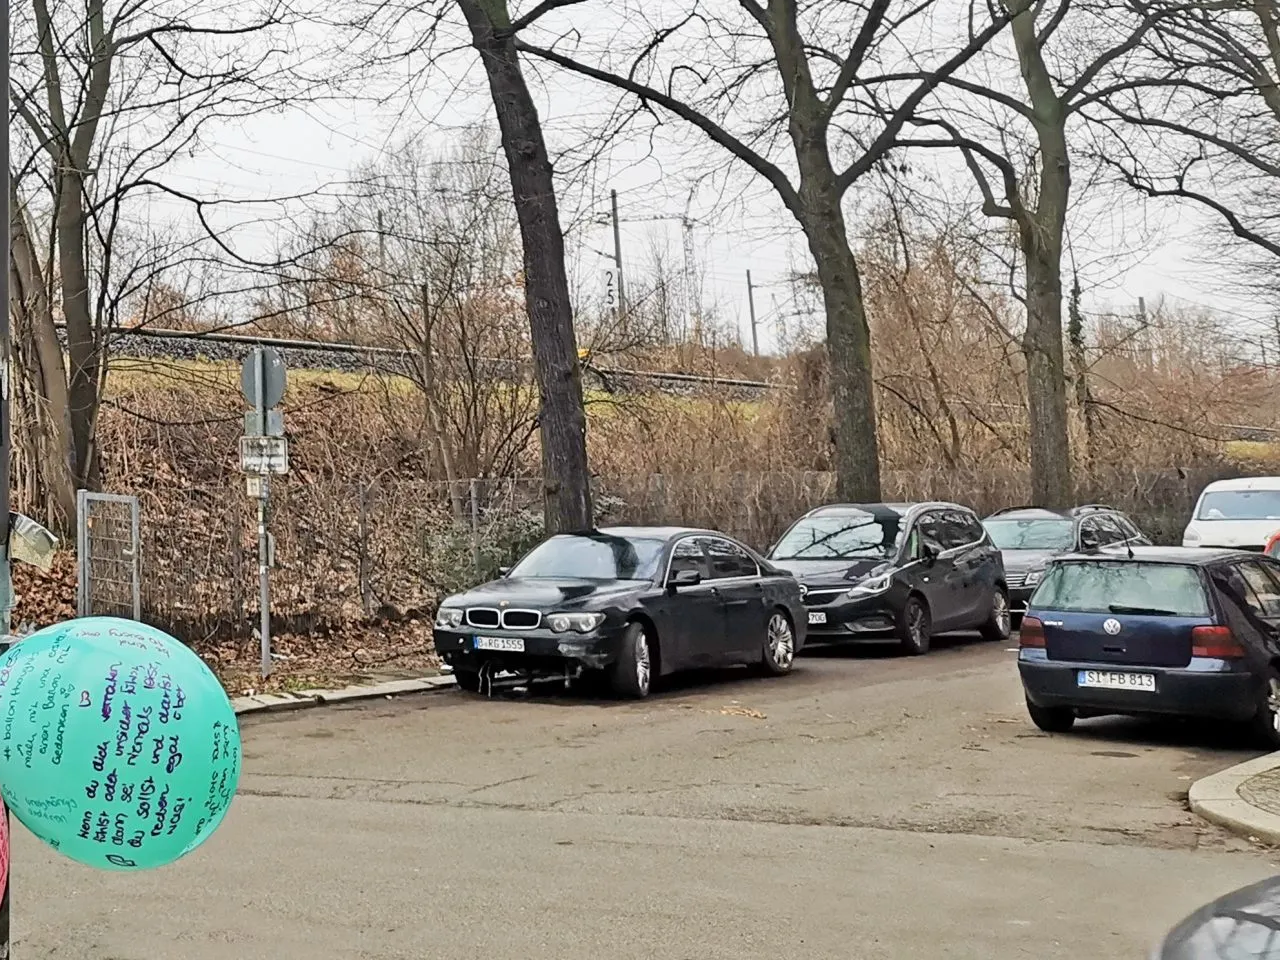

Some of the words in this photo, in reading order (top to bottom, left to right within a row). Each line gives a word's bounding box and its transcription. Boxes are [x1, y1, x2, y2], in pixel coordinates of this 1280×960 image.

[1110, 672, 1126, 685] FB
[1129, 673, 1153, 687] 813
[92, 740, 112, 772] dich
[166, 734, 183, 774] egal
[85, 779, 100, 799] du
[127, 830, 145, 848] du
[136, 775, 156, 819] sollst
